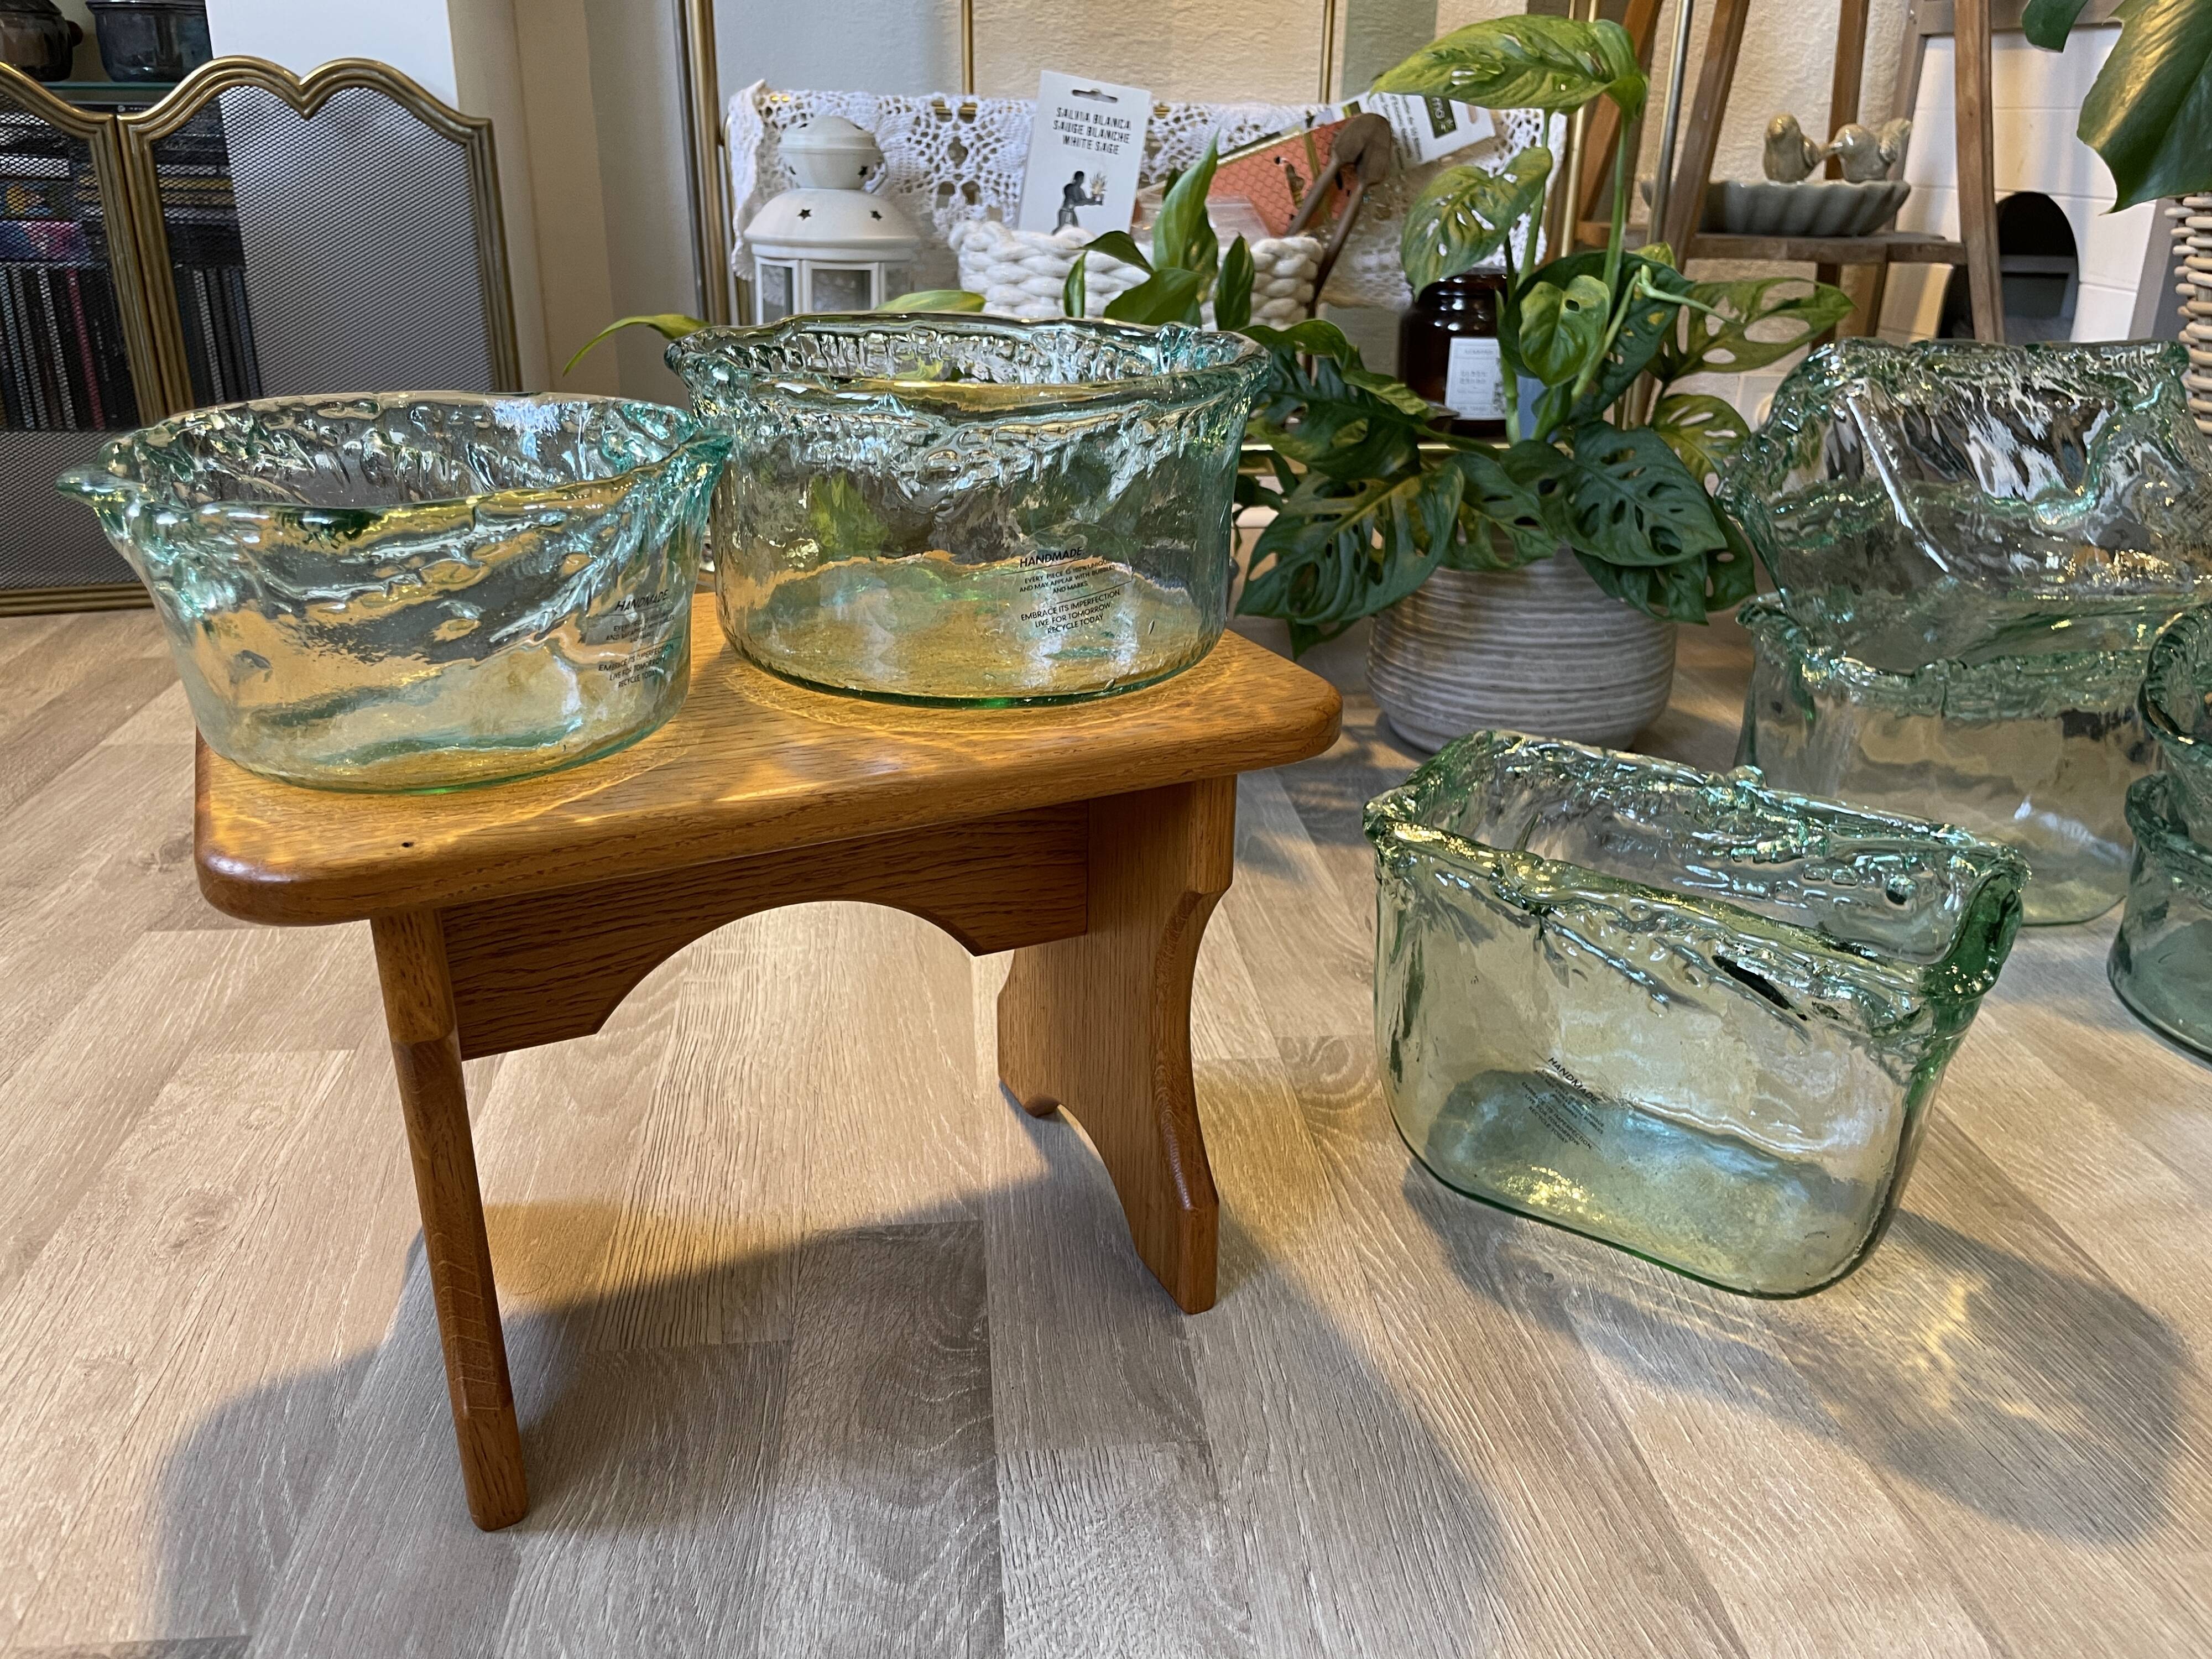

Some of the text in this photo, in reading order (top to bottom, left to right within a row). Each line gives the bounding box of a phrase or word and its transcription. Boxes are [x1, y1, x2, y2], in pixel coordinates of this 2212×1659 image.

[1056, 107, 1131, 131] SALVIA BLANCA
[1053, 120, 1130, 144] SAUGE BLANCHE
[1063, 134, 1120, 155] WHITE SAGE
[1019, 564, 1115, 593] AND MAY APPEAR WITH BUBBLES
[1025, 575, 1043, 584] EVERY
[1046, 570, 1062, 580] PIECE
[615, 589, 669, 612] HANDMADE
[1052, 586, 1066, 594] AND
[1021, 607, 1057, 621] EMBRACE
[1058, 604, 1070, 613] ITS
[1035, 619, 1049, 628] LIVE
[1052, 615, 1067, 624] FOR
[1047, 613, 1104, 634] RECYCLE TODAY
